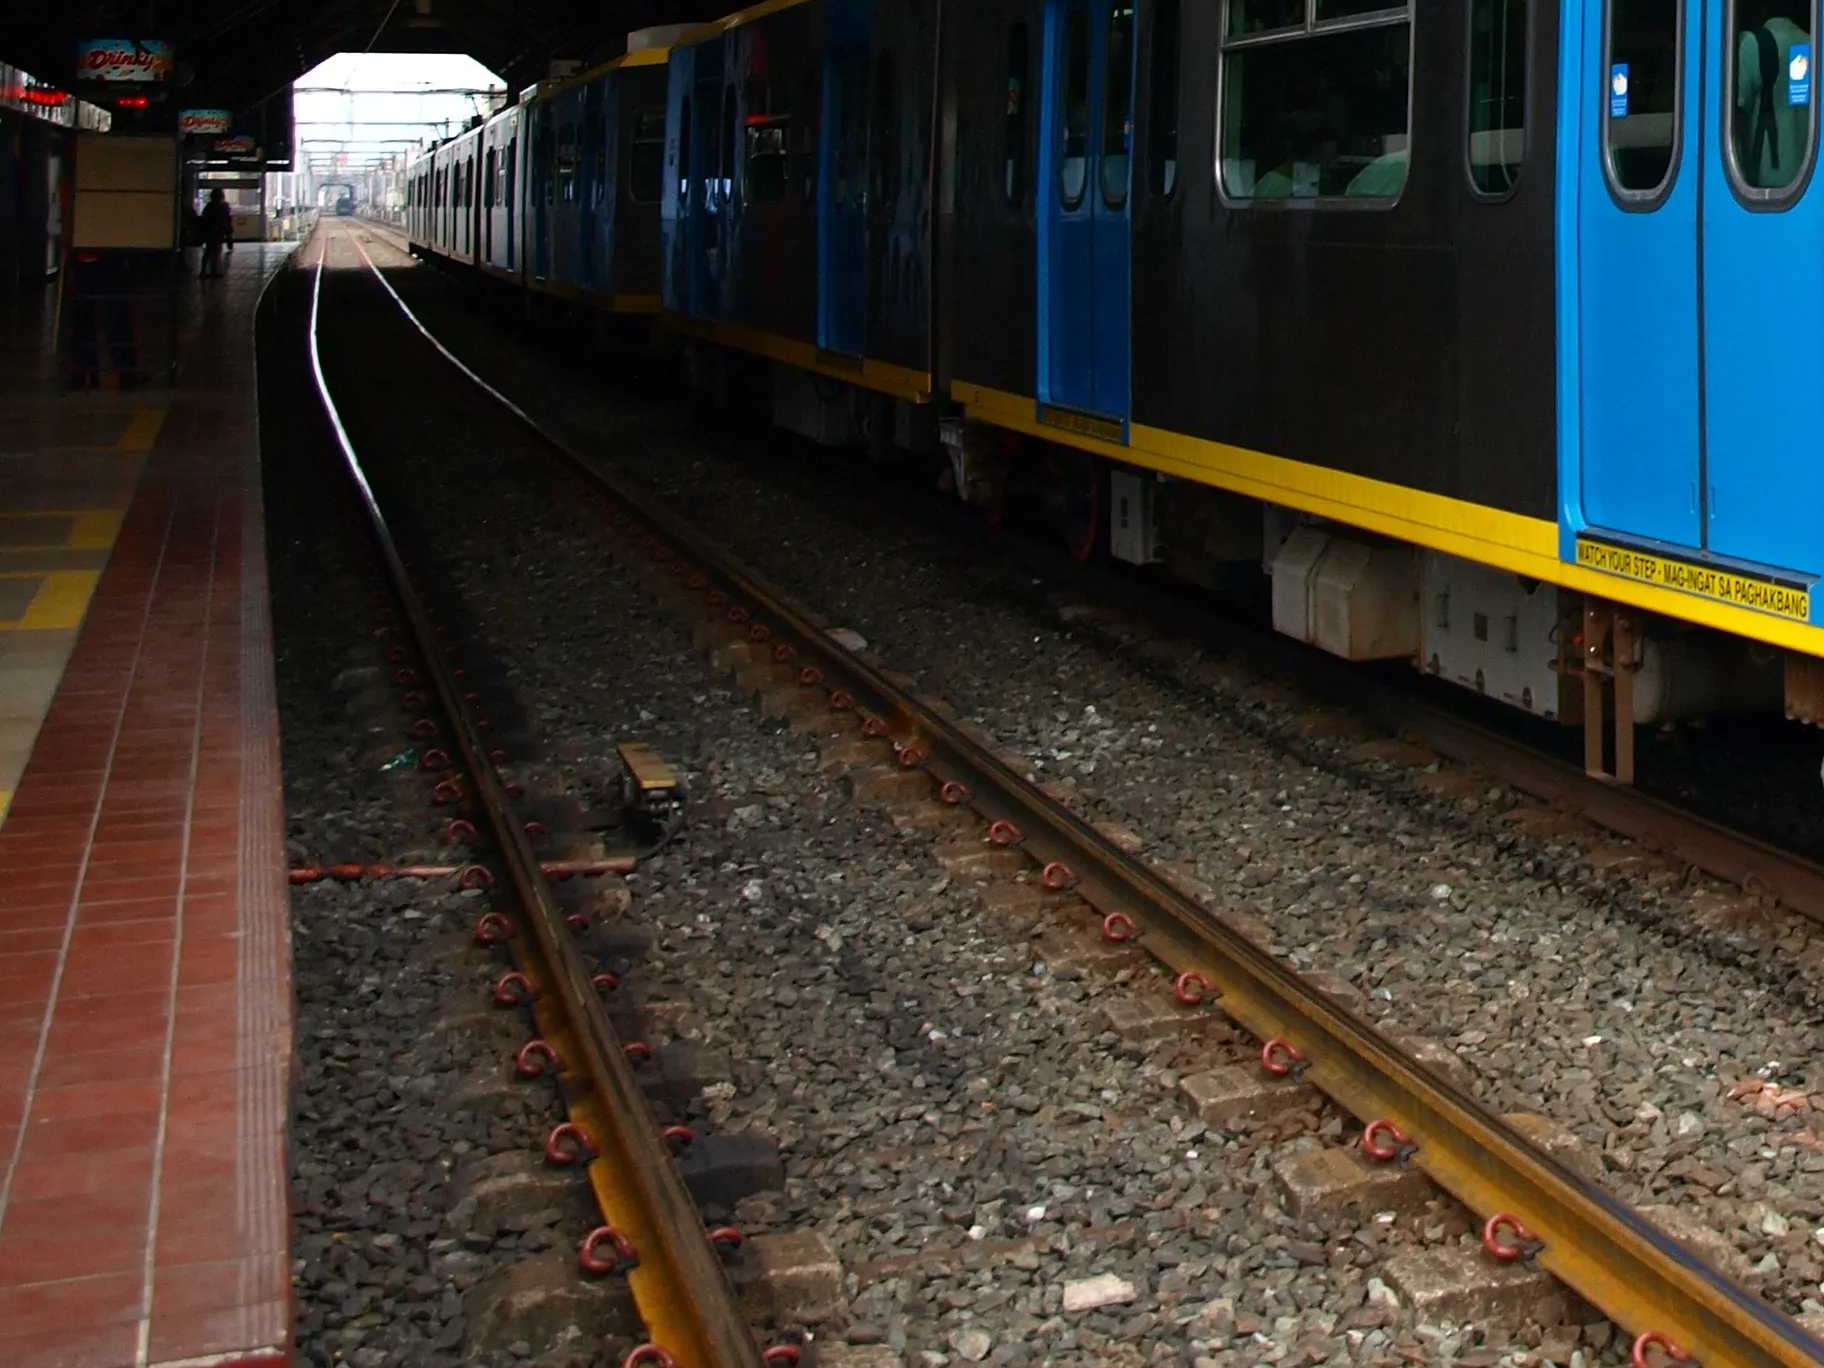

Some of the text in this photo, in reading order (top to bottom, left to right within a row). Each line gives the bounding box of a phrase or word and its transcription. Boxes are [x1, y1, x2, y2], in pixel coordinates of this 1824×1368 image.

[1578, 543, 1606, 566] WATCH
[1607, 549, 1631, 574] YOUR
[1633, 555, 1656, 579] STEP
[1664, 562, 1716, 593] MAG-INGAT
[1718, 576, 1732, 598] SA
[1734, 580, 1808, 618] PAGHAKBANG
